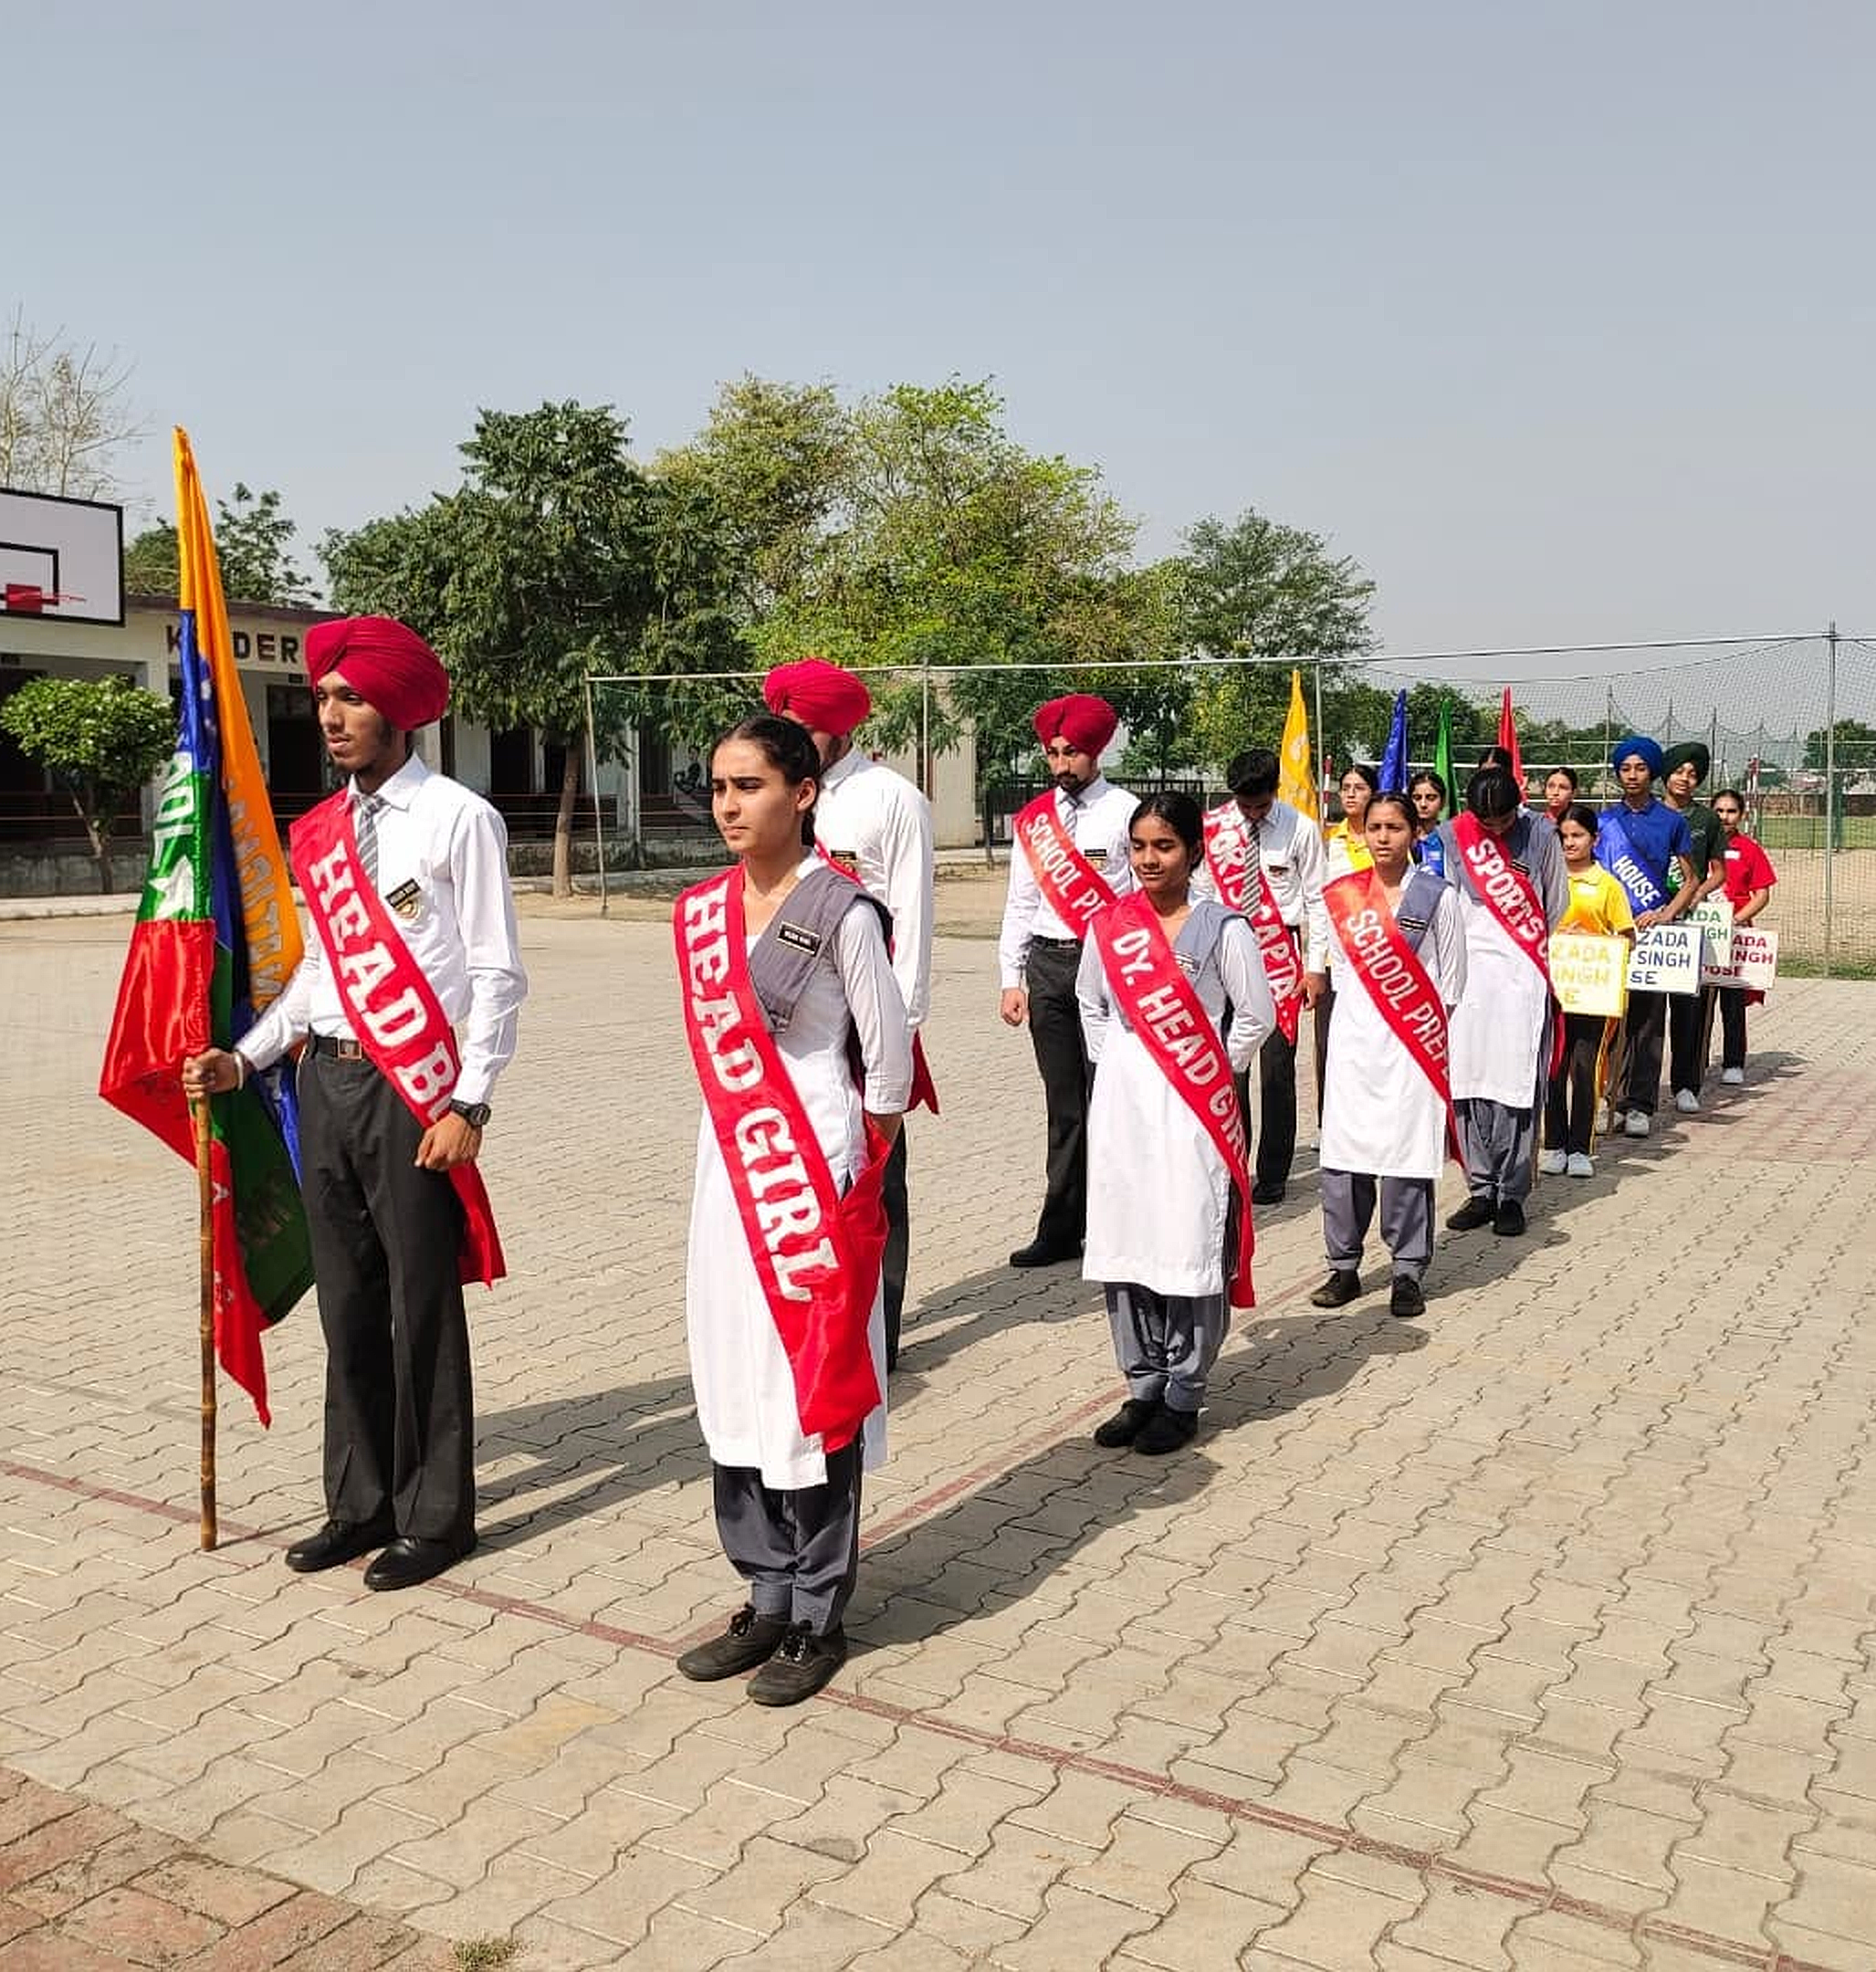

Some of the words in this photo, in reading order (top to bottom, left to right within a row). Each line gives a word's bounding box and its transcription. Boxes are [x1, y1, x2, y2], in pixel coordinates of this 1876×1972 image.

[1026, 813, 1083, 898] SCHOOL
[1467, 839, 1545, 941] SPORTS
[1612, 855, 1661, 907] HOUSE
[309, 840, 429, 1048] HEAD
[1347, 909, 1420, 1011] SCHOOL
[1637, 930, 1688, 949] ZADA
[1637, 950, 1692, 969] SINGH
[1706, 928, 1728, 940] GH
[1111, 928, 1154, 987] DY.
[1137, 984, 1221, 1086] HEAD
[1630, 970, 1659, 985] SE
[686, 879, 764, 1093] HEAD
[735, 1107, 840, 1302] GIRL
